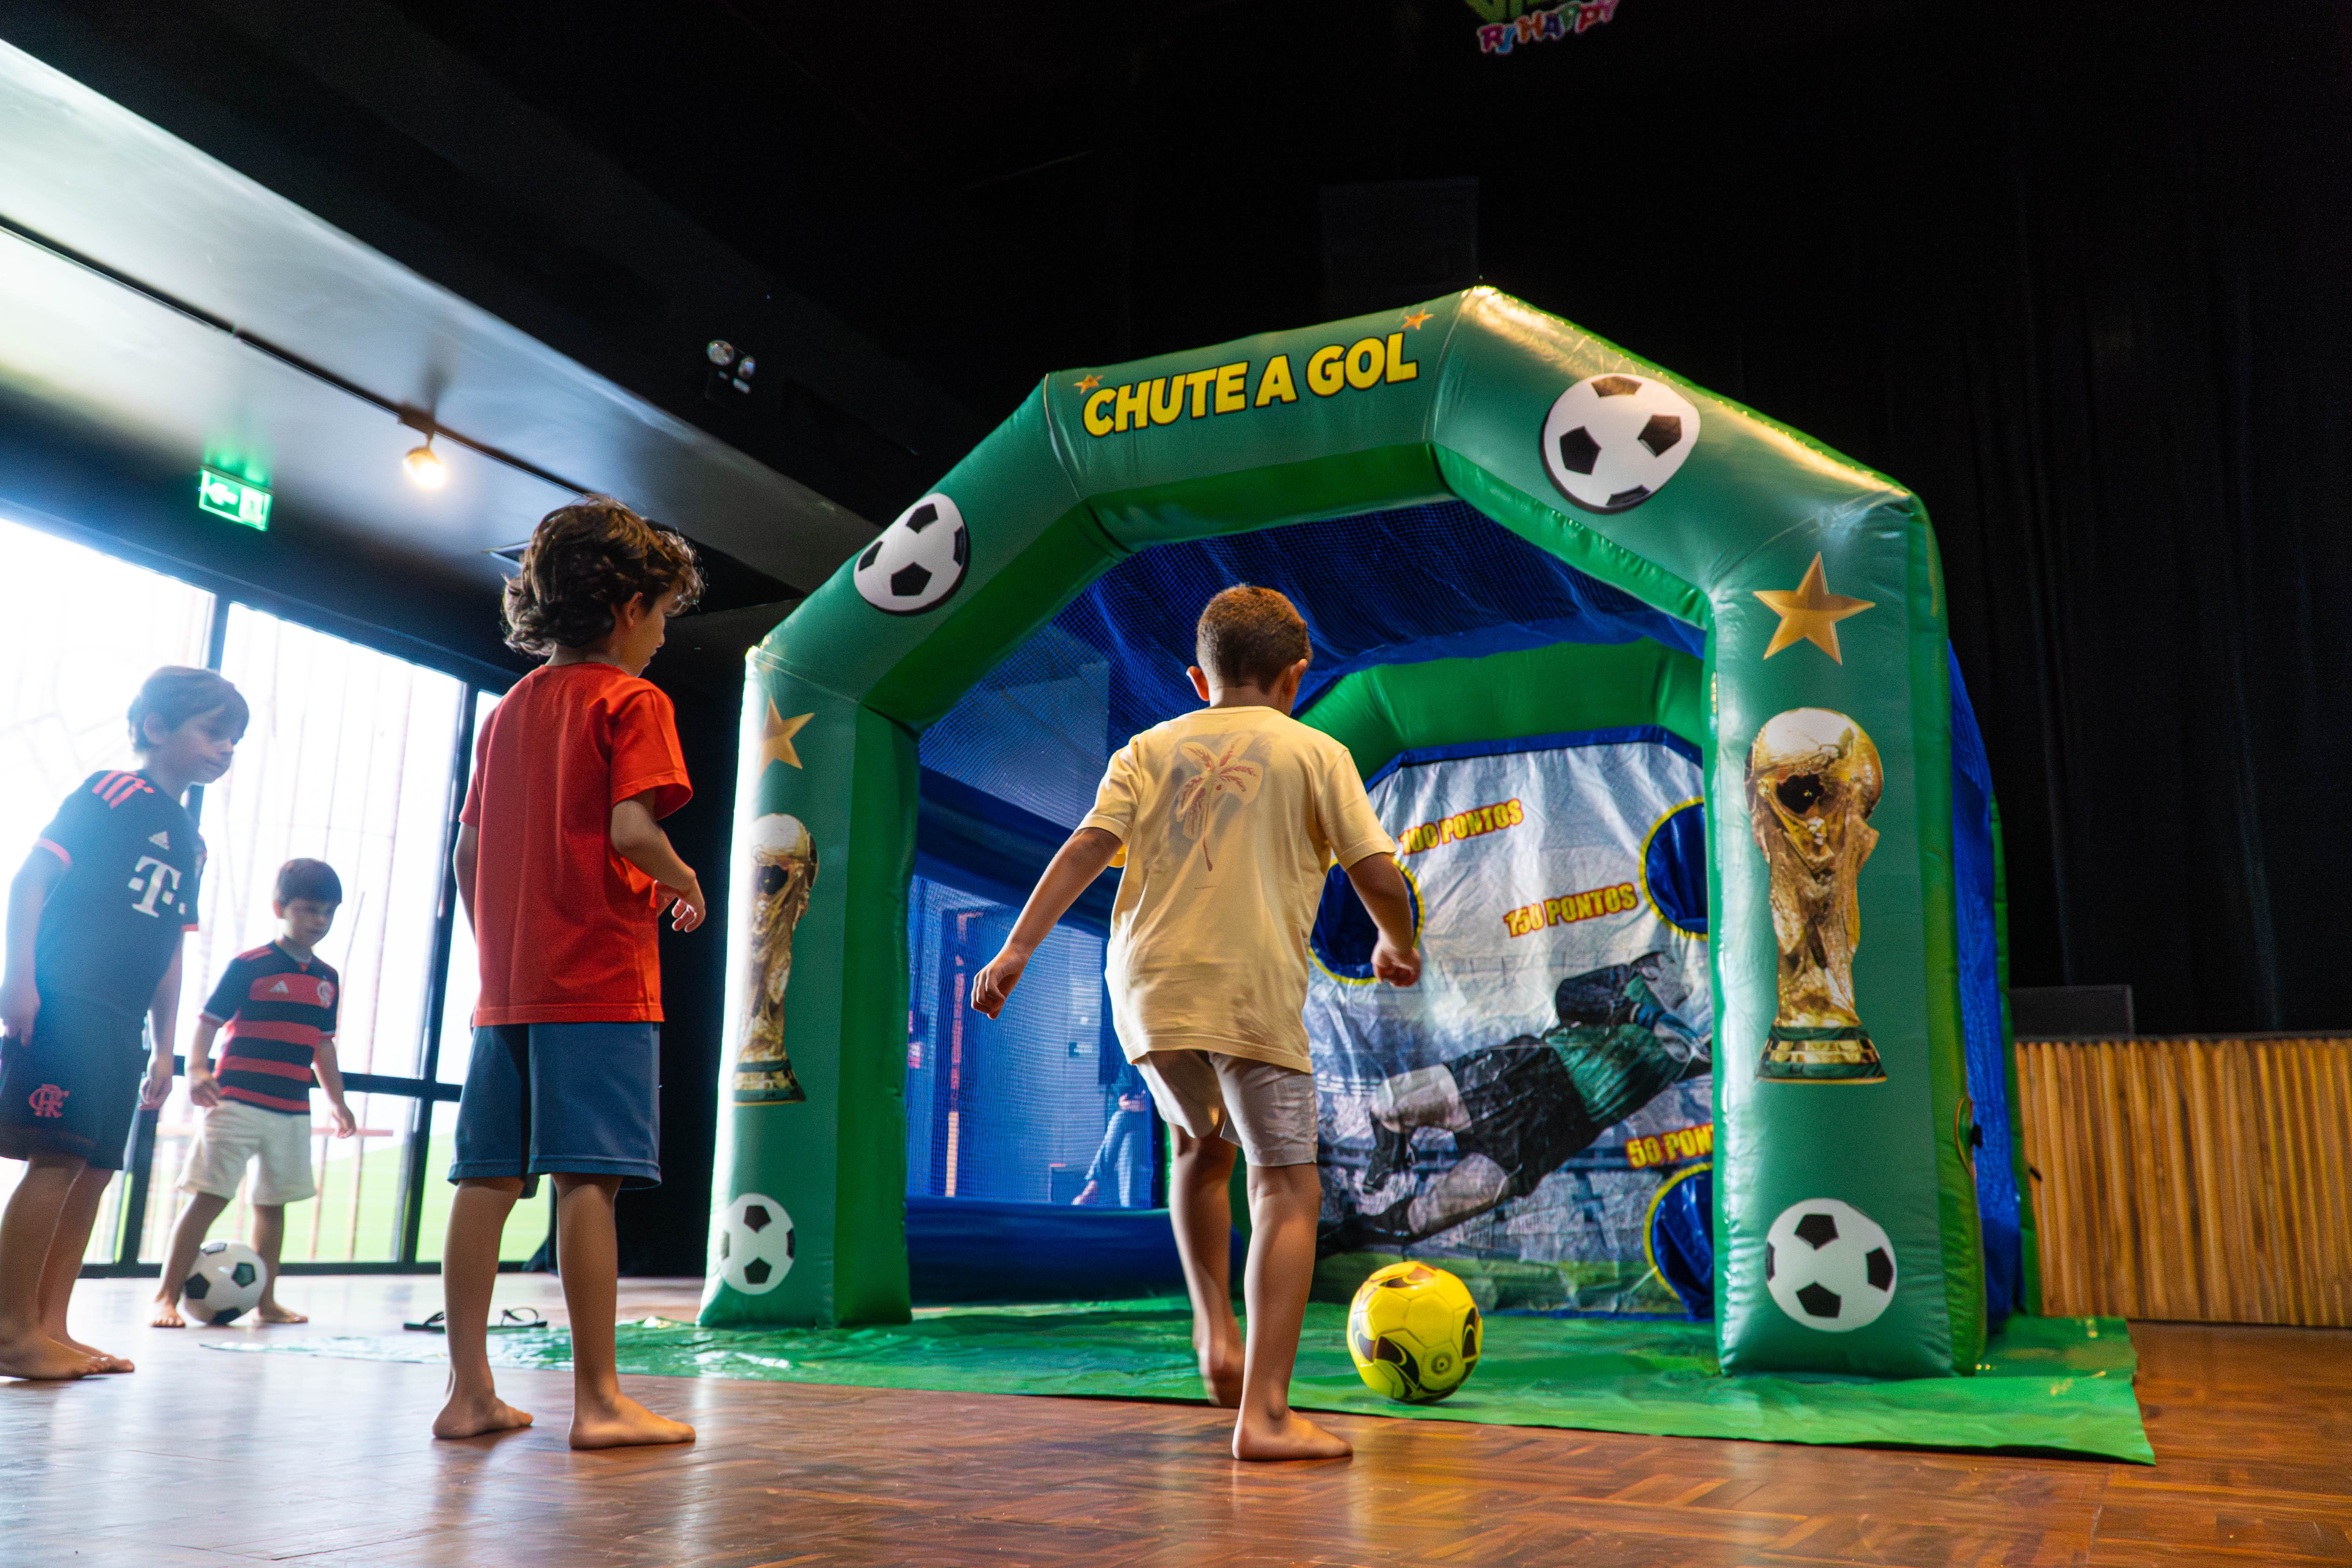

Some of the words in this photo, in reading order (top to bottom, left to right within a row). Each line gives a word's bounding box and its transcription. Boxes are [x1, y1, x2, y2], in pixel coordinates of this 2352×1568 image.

[1083, 360, 1250, 438] CHUTE
[1253, 353, 1299, 408] A
[1306, 331, 1419, 397] GOL
[1398, 822, 1439, 856] 100
[1438, 798, 1524, 844] PONTOS
[1503, 903, 1545, 938] 150
[1543, 882, 1639, 927] PONTOS
[1625, 1136, 1662, 1169] 50
[1662, 1123, 1713, 1162] PON
